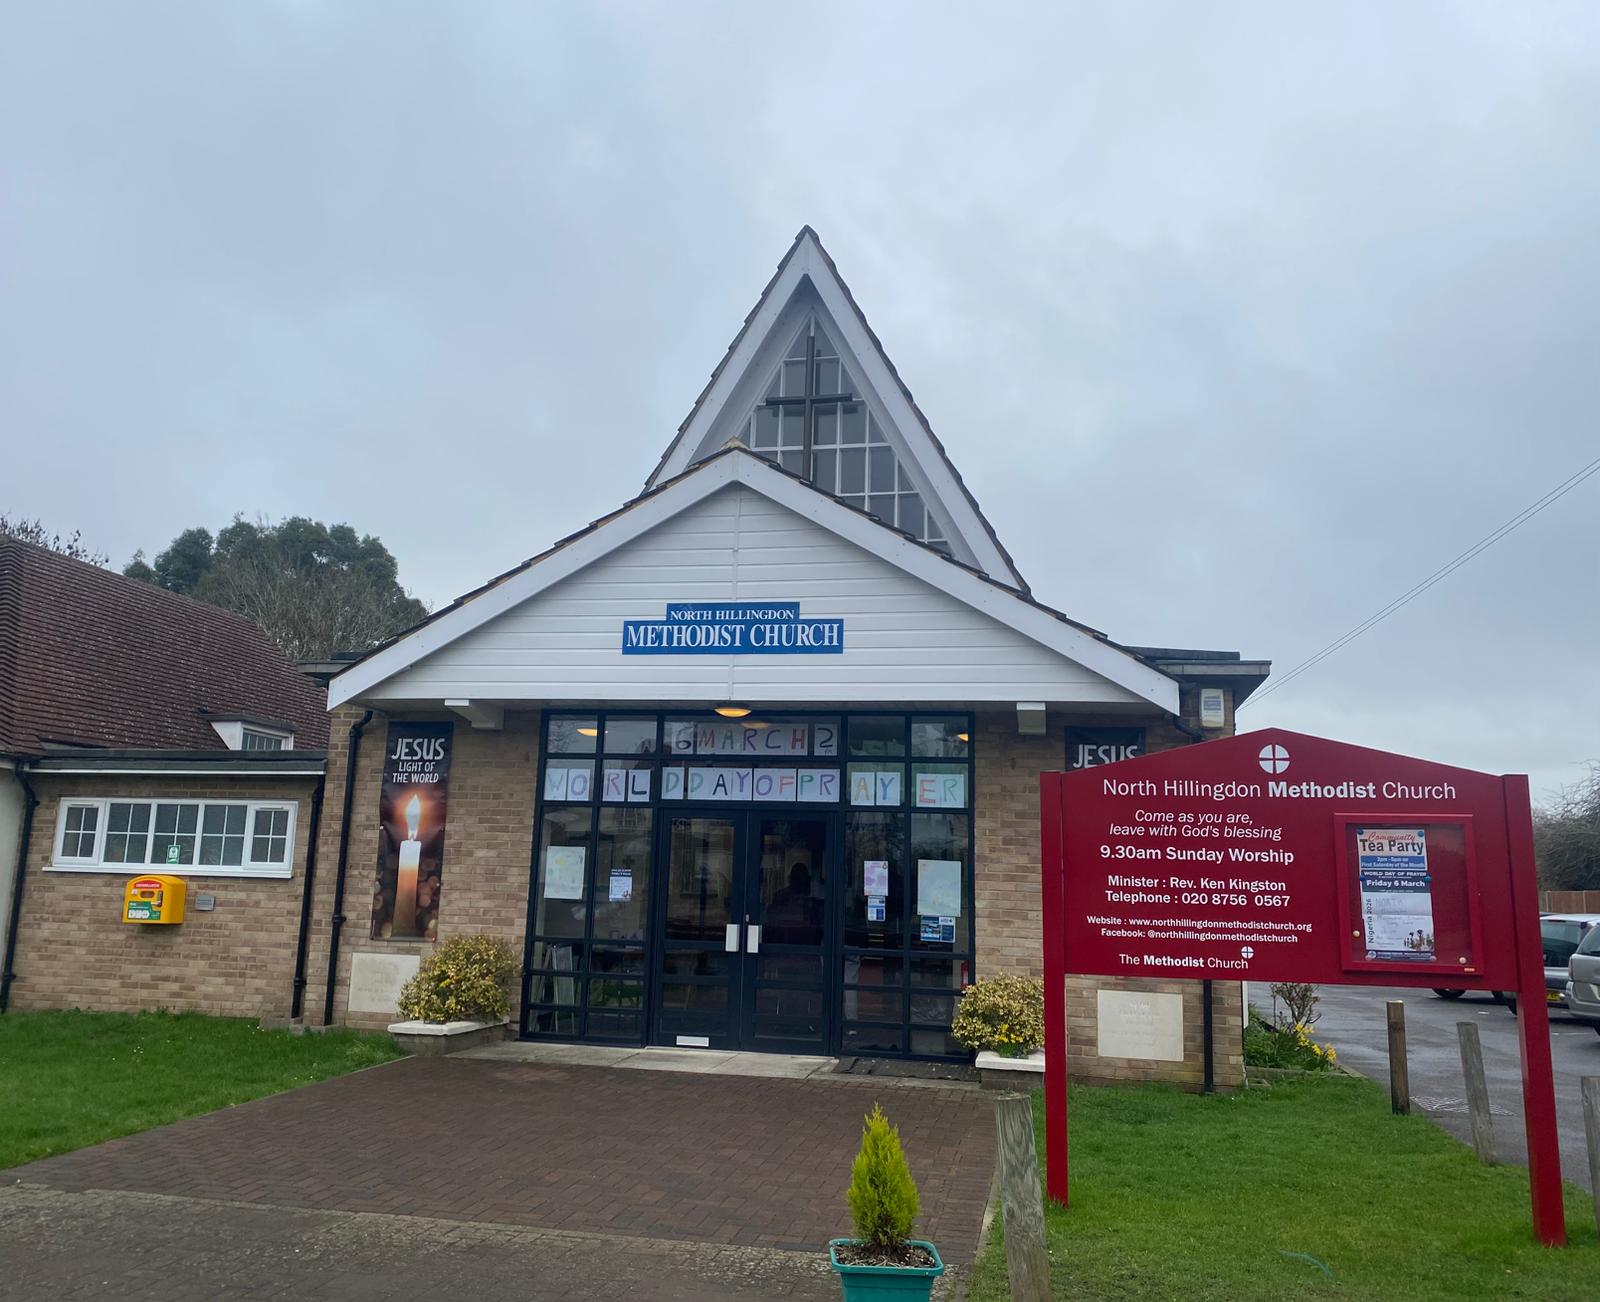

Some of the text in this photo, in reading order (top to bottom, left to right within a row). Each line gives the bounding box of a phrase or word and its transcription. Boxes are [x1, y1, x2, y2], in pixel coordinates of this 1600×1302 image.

[670, 609, 795, 621] NORTH HILLINGDON
[626, 622, 840, 648] METHODIST CHURCH
[675, 726, 692, 750] 6
[699, 727, 806, 751] MARCH
[391, 738, 446, 760] JESUS
[399, 761, 436, 772] LIGHT OF
[392, 772, 439, 783] THE WORLD
[1103, 779, 1457, 801] North Hillingdon Methodist Church
[1134, 809, 1253, 826] Come as you are,
[1109, 823, 1282, 841] leave with God's blessing
[1367, 831, 1416, 842] Community
[1100, 845, 1294, 865] 9.30am Sunday Worship
[1360, 838, 1425, 855] Tea Party
[1107, 875, 1159, 888] Minister
[1170, 877, 1197, 889] Rev.
[1200, 878, 1225, 890] Ken
[1229, 878, 1286, 892] Kingston
[1366, 879, 1392, 887] Friday
[1105, 890, 1171, 906] Telephone
[1181, 892, 1208, 905] 020
[1211, 893, 1247, 906] 8756
[1254, 894, 1291, 907] 0567
[1086, 915, 1122, 926] Website
[1129, 917, 1313, 932] www.northhillingdonmethodistchurch.org
[1366, 916, 1375, 944] Nigeria
[1101, 927, 1298, 943] Facebook: @northhillingdonmethodistchurch
[1119, 953, 1249, 969] The Methodist Church
